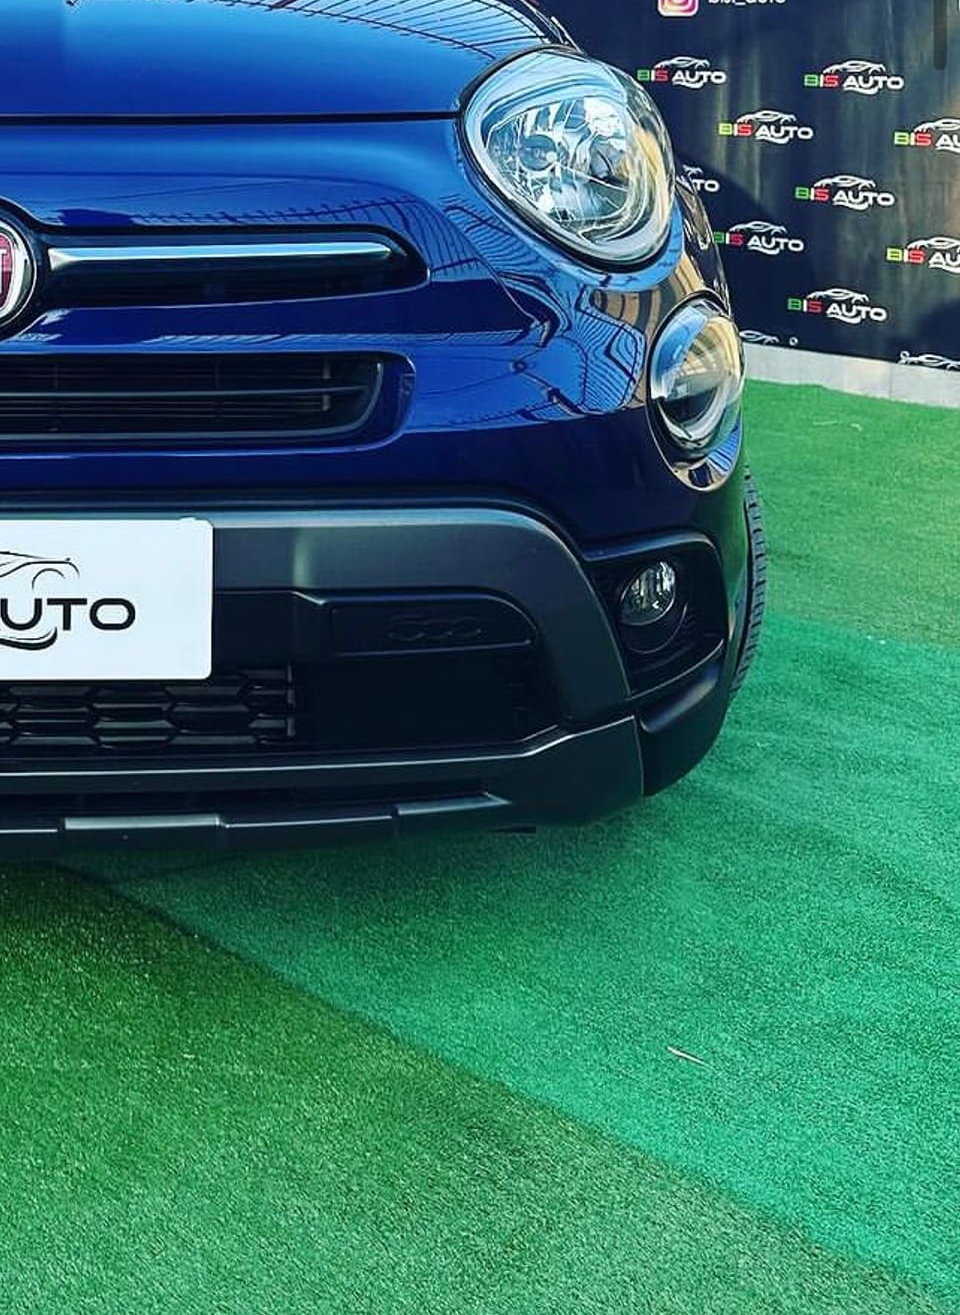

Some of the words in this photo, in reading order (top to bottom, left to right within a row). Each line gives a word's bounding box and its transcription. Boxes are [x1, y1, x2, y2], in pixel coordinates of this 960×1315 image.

[637, 69, 668, 81] BIS
[672, 71, 727, 84] AUTO
[804, 74, 838, 87] BIS
[842, 76, 904, 90] AUTO
[718, 123, 752, 136] BIS
[757, 126, 814, 140] AUTO
[894, 132, 931, 146] BIS
[795, 187, 829, 201] BIS
[833, 190, 894, 205] AUTO
[713, 232, 743, 245] BIS
[747, 235, 804, 252] AUTO
[886, 248, 924, 263] BIS
[787, 298, 822, 312] BIS
[826, 303, 887, 321] AUTO
